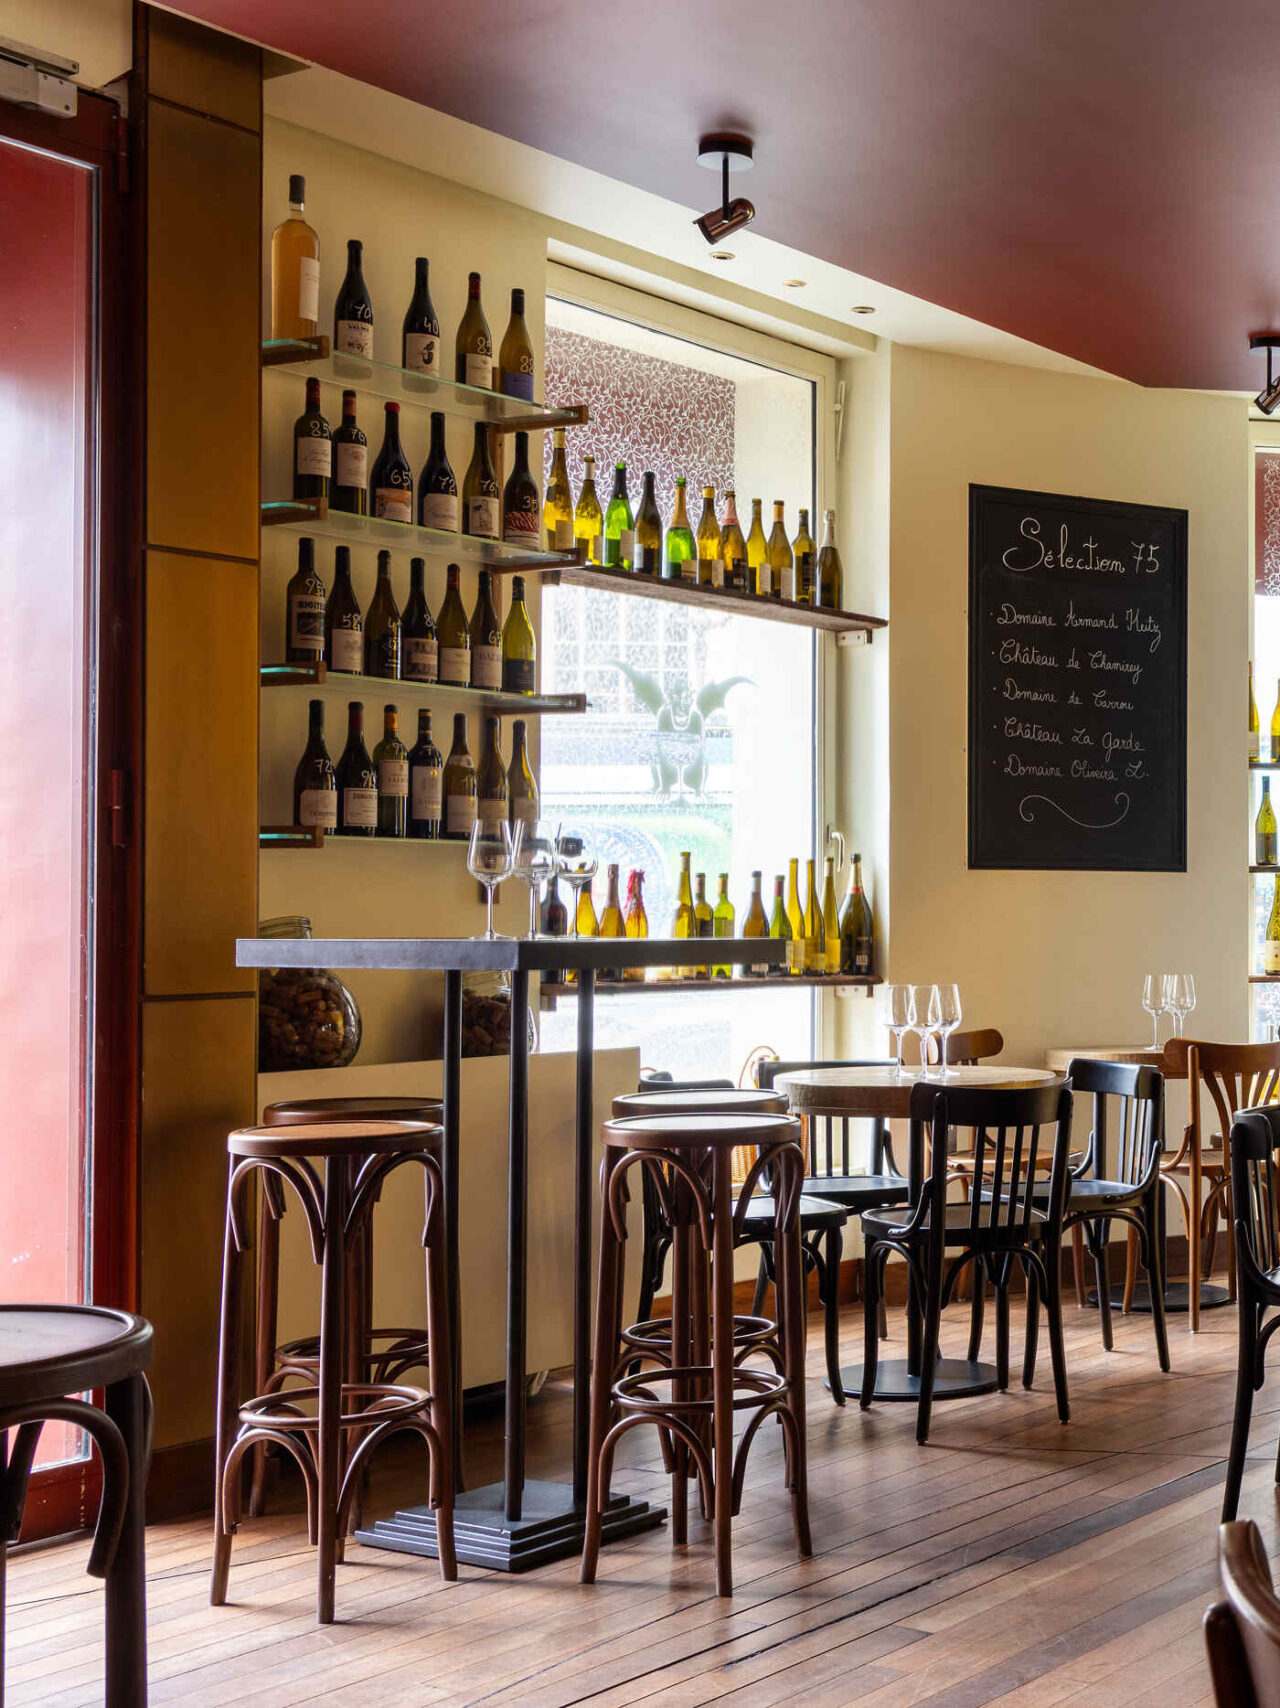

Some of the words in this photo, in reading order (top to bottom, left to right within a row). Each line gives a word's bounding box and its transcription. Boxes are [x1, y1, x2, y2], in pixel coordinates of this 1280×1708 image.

[390, 469, 411, 486] 65
[438, 475, 456, 492] 72
[480, 479, 496, 492] 76
[1003, 517, 1126, 574] Sélection
[1131, 541, 1160, 574] 75
[997, 603, 1056, 625] Domaine
[1064, 600, 1118, 628] Armand
[999, 638, 1059, 668] Château
[1066, 647, 1081, 670] de
[1003, 678, 1058, 703] Domaine
[1068, 691, 1084, 705] de
[1004, 717, 1063, 745] Château
[1072, 728, 1095, 745] La
[1004, 753, 1063, 777] Domaine
